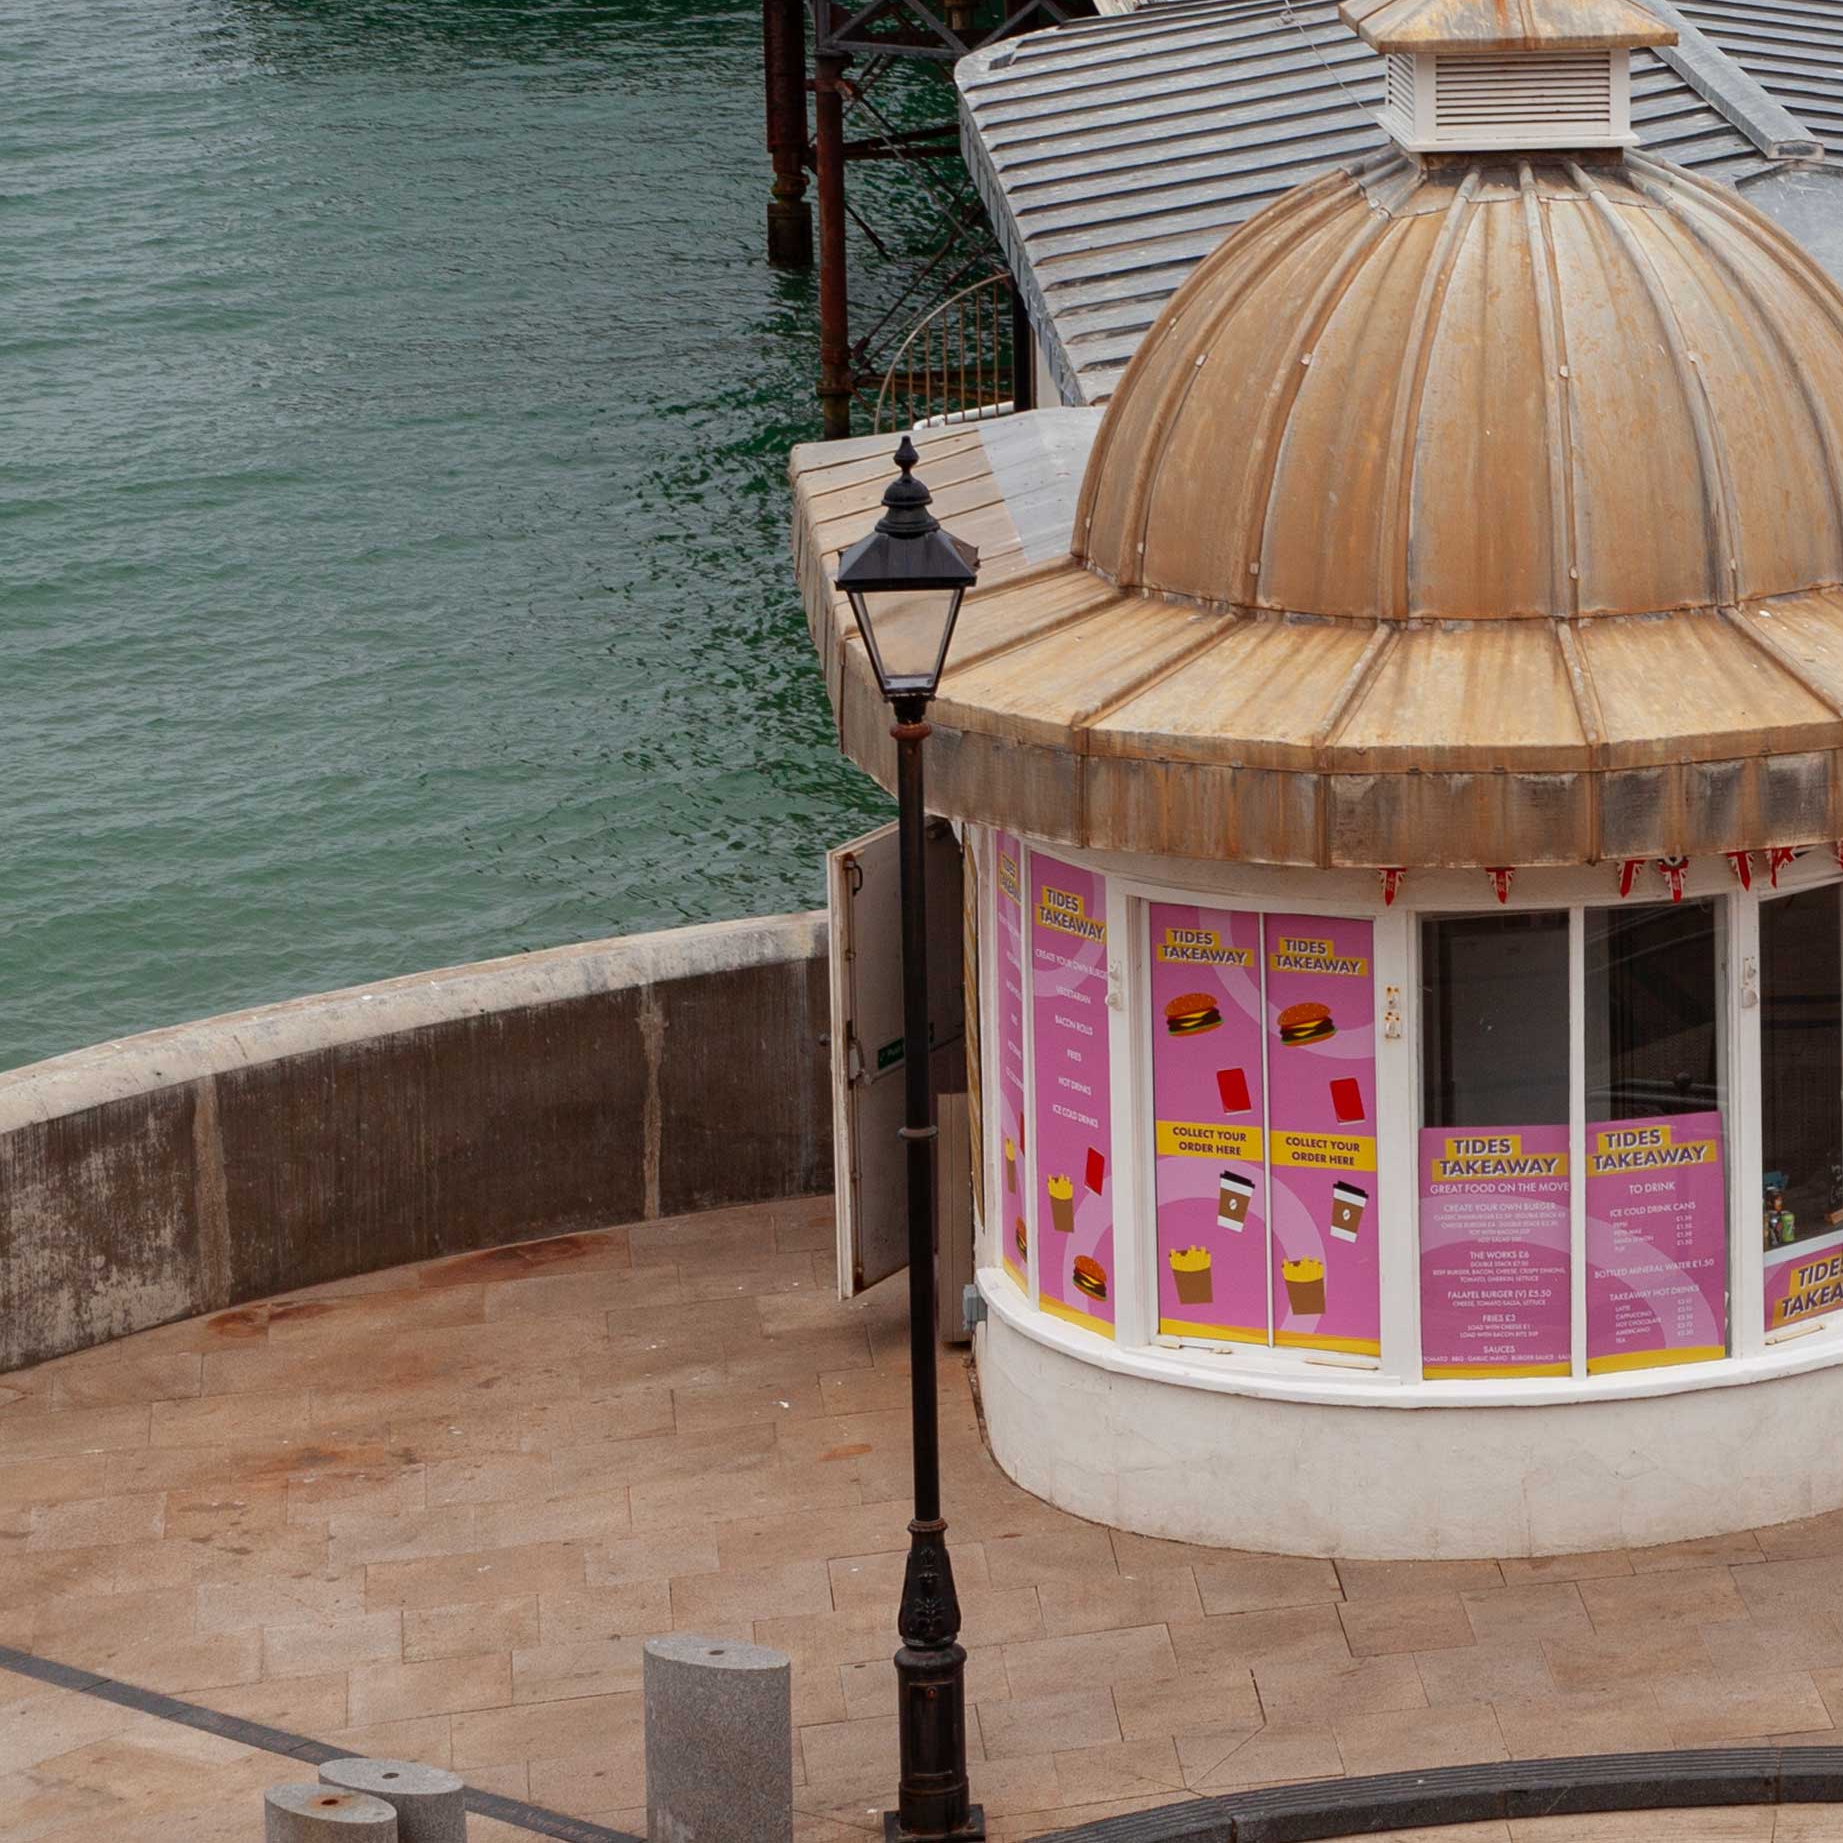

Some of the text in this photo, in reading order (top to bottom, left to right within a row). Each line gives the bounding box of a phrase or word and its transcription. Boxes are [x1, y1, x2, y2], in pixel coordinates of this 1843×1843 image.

[1046, 888, 1080, 913] TIDES
[1039, 906, 1105, 941] TAKEAWAY
[1171, 930, 1214, 945] TIDES
[1163, 945, 1247, 965] TAKEAWAY
[1284, 939, 1327, 955] TIDES
[1275, 955, 1360, 975] TAKEAWAY
[1173, 1126, 1247, 1142] COLLECT YOUR
[1604, 1129, 1663, 1149] TIDES
[1178, 1142, 1241, 1156] ORDER HERE
[1285, 1136, 1360, 1152] COLLECT YOUR
[1453, 1138, 1512, 1156] TIDES
[1291, 1151, 1355, 1166] ORDER HERE
[1593, 1145, 1707, 1172] TAKEAWAY
[1440, 1157, 1558, 1178] TAKEAWAY
[1430, 1182, 1569, 1194] GREAT FOOD ON THE MOVE
[1629, 1181, 1676, 1194] TO DRINK
[1624, 1202, 1696, 1216] COLD DRINK CANS
